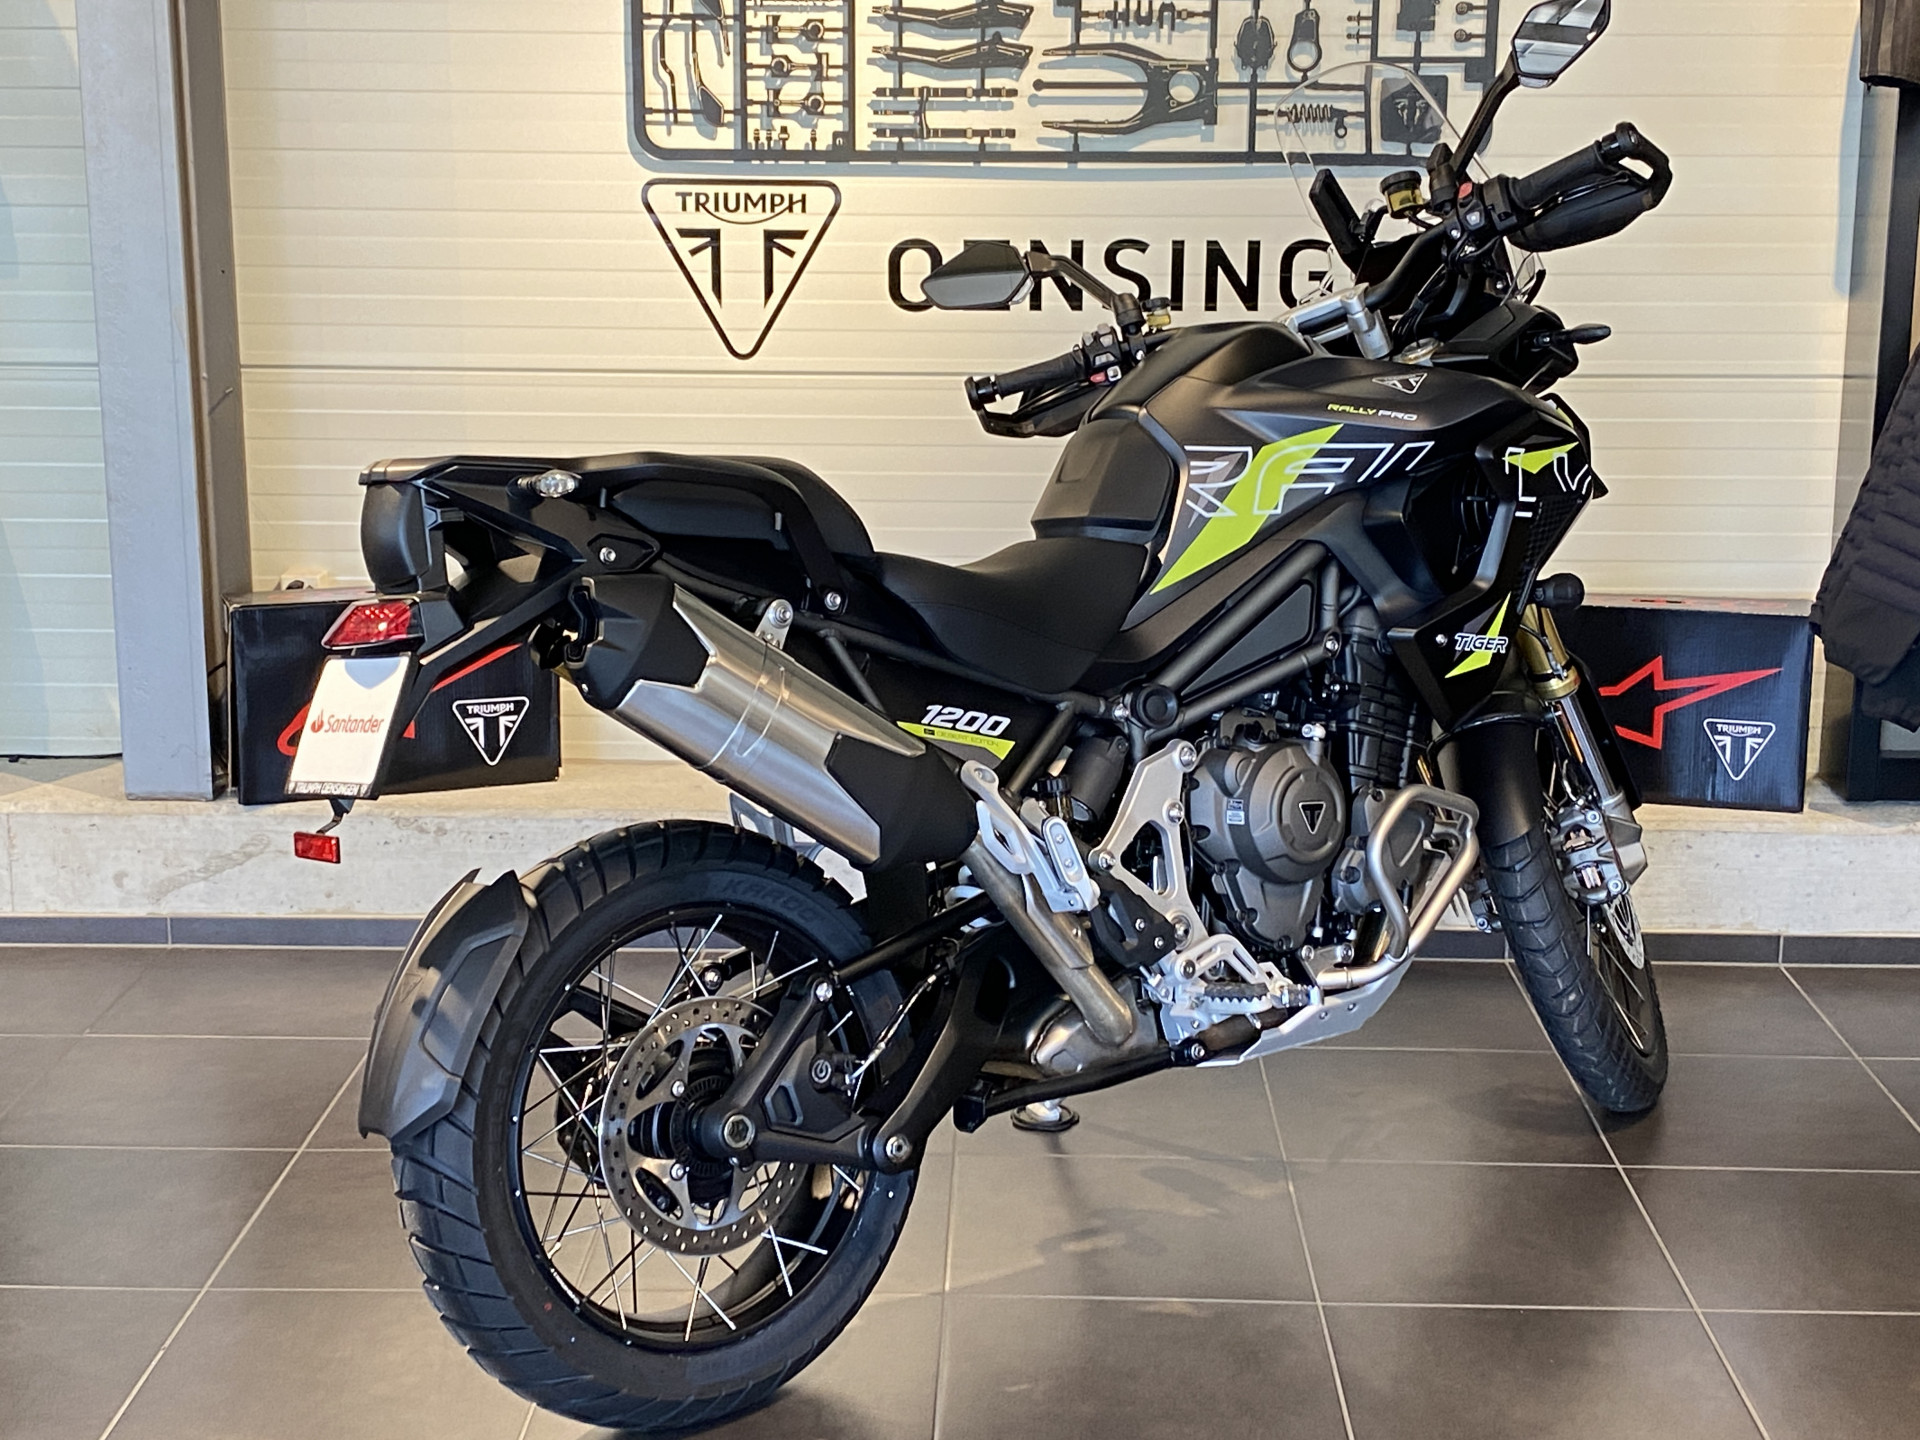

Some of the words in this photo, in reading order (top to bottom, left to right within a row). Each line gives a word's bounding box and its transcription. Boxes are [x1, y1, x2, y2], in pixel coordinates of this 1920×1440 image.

[675, 191, 807, 225] TRIUMPH
[1327, 403, 1377, 415] RALLY
[1378, 409, 1418, 421] PRO
[1454, 632, 1508, 654] TIGER
[466, 702, 515, 717] TRIUMPH
[324, 714, 384, 734] Santander
[921, 704, 1012, 737] 1200
[1716, 723, 1762, 737] TRIUMPH
